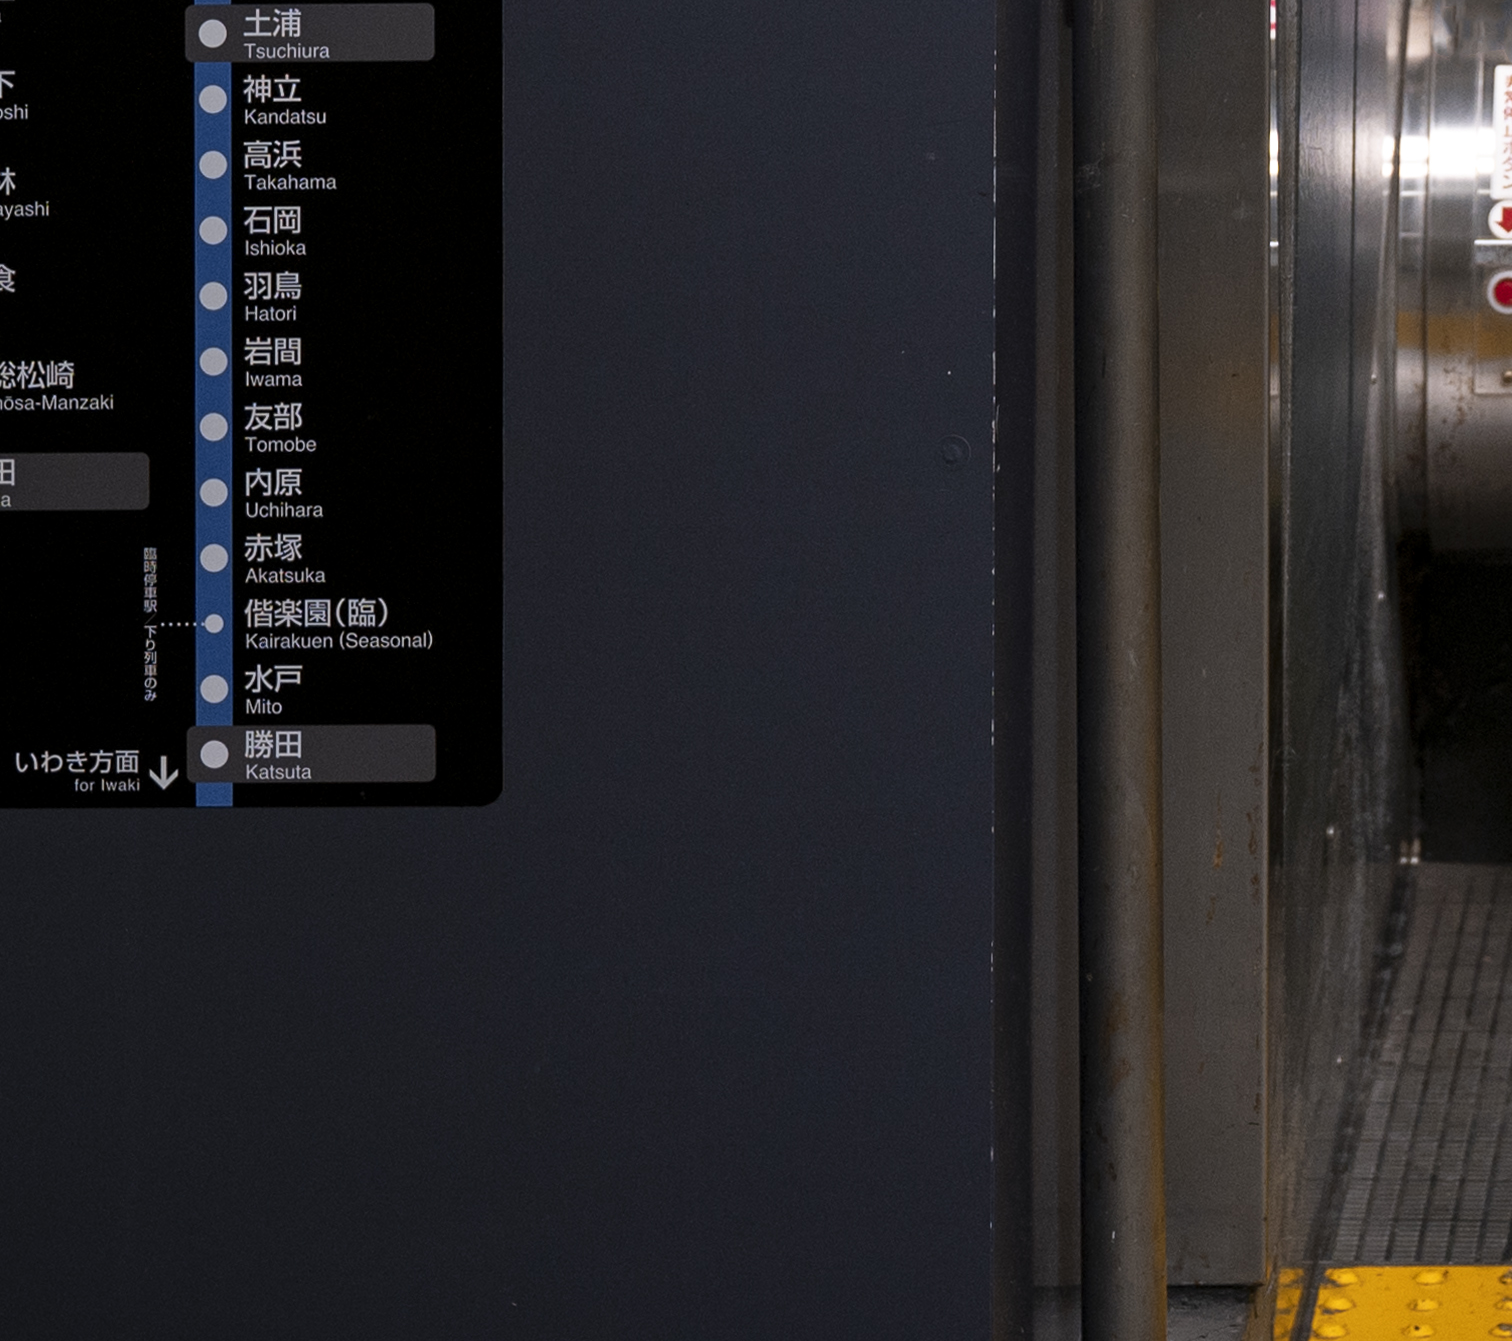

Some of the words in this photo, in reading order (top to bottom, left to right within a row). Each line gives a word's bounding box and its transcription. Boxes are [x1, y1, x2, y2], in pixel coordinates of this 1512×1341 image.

[244, 8, 301, 37] 土浦
[244, 43, 330, 59] Tsuchiura
[244, 74, 301, 103] 神立
[245, 109, 326, 124] Kandatsu
[244, 140, 301, 168] 高浜
[244, 174, 336, 190] Takahama
[244, 206, 300, 234] 石岡
[246, 240, 306, 256] Ishioka
[244, 271, 302, 300] 羽鳥
[246, 305, 296, 321] Hatori
[244, 337, 301, 365] 岩間
[246, 371, 302, 386] Iwama
[245, 402, 302, 430] 友部
[245, 436, 316, 452] Tomobe
[246, 468, 302, 496] 内原
[246, 502, 323, 518] Uchihara
[245, 533, 302, 562] 赤塚
[245, 568, 325, 583] Akatsuka
[246, 633, 333, 649] Kairakuen
[340, 630, 432, 649] (Seasonal)
[245, 664, 302, 693] 水戸
[246, 699, 282, 714] Mito
[245, 730, 301, 758] 勝田
[16, 750, 139, 773] いわき方面
[246, 764, 311, 780] Katsuta
[75, 779, 95, 791] for
[102, 779, 140, 791] Iwaki
